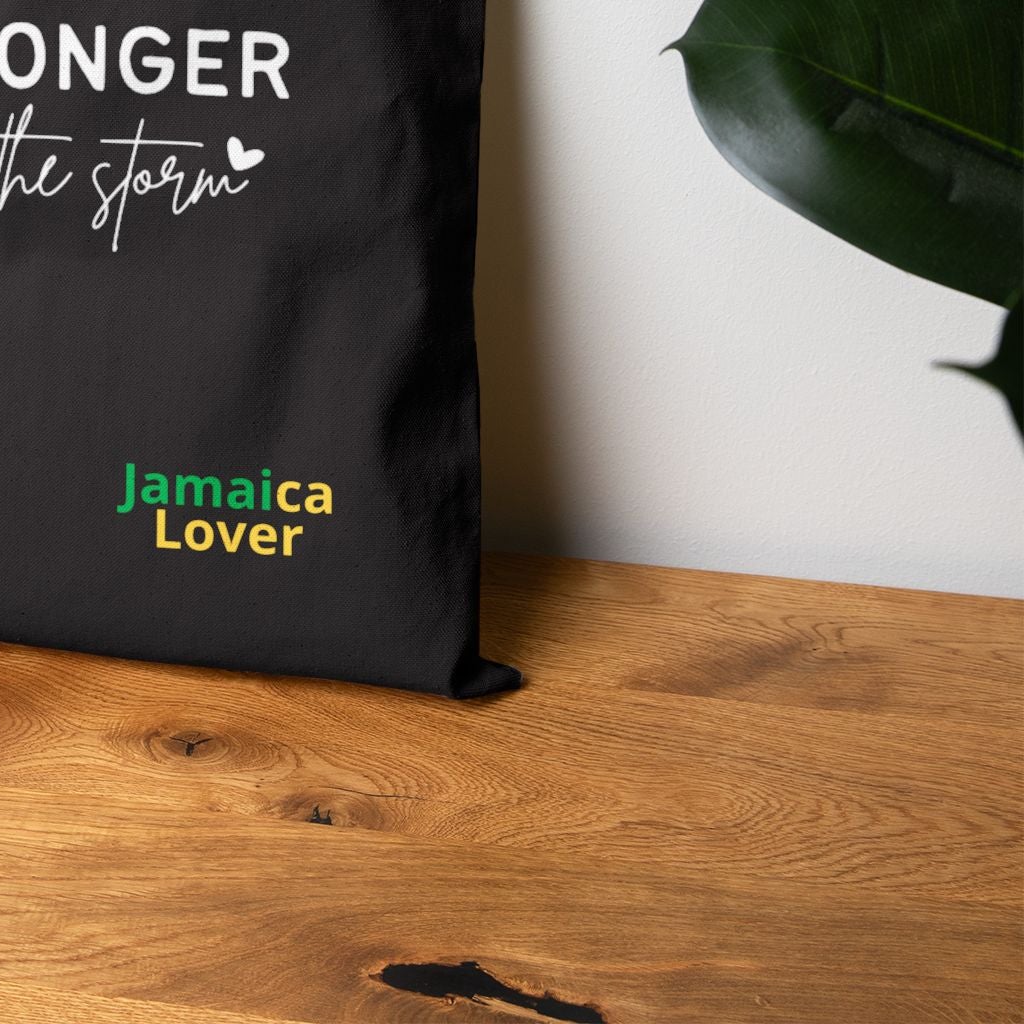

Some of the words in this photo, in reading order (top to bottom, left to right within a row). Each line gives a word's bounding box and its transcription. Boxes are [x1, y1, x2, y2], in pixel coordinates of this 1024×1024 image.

[91, 117, 250, 253] storm
[116, 462, 333, 515] Jamaica
[155, 508, 304, 557] Lover
